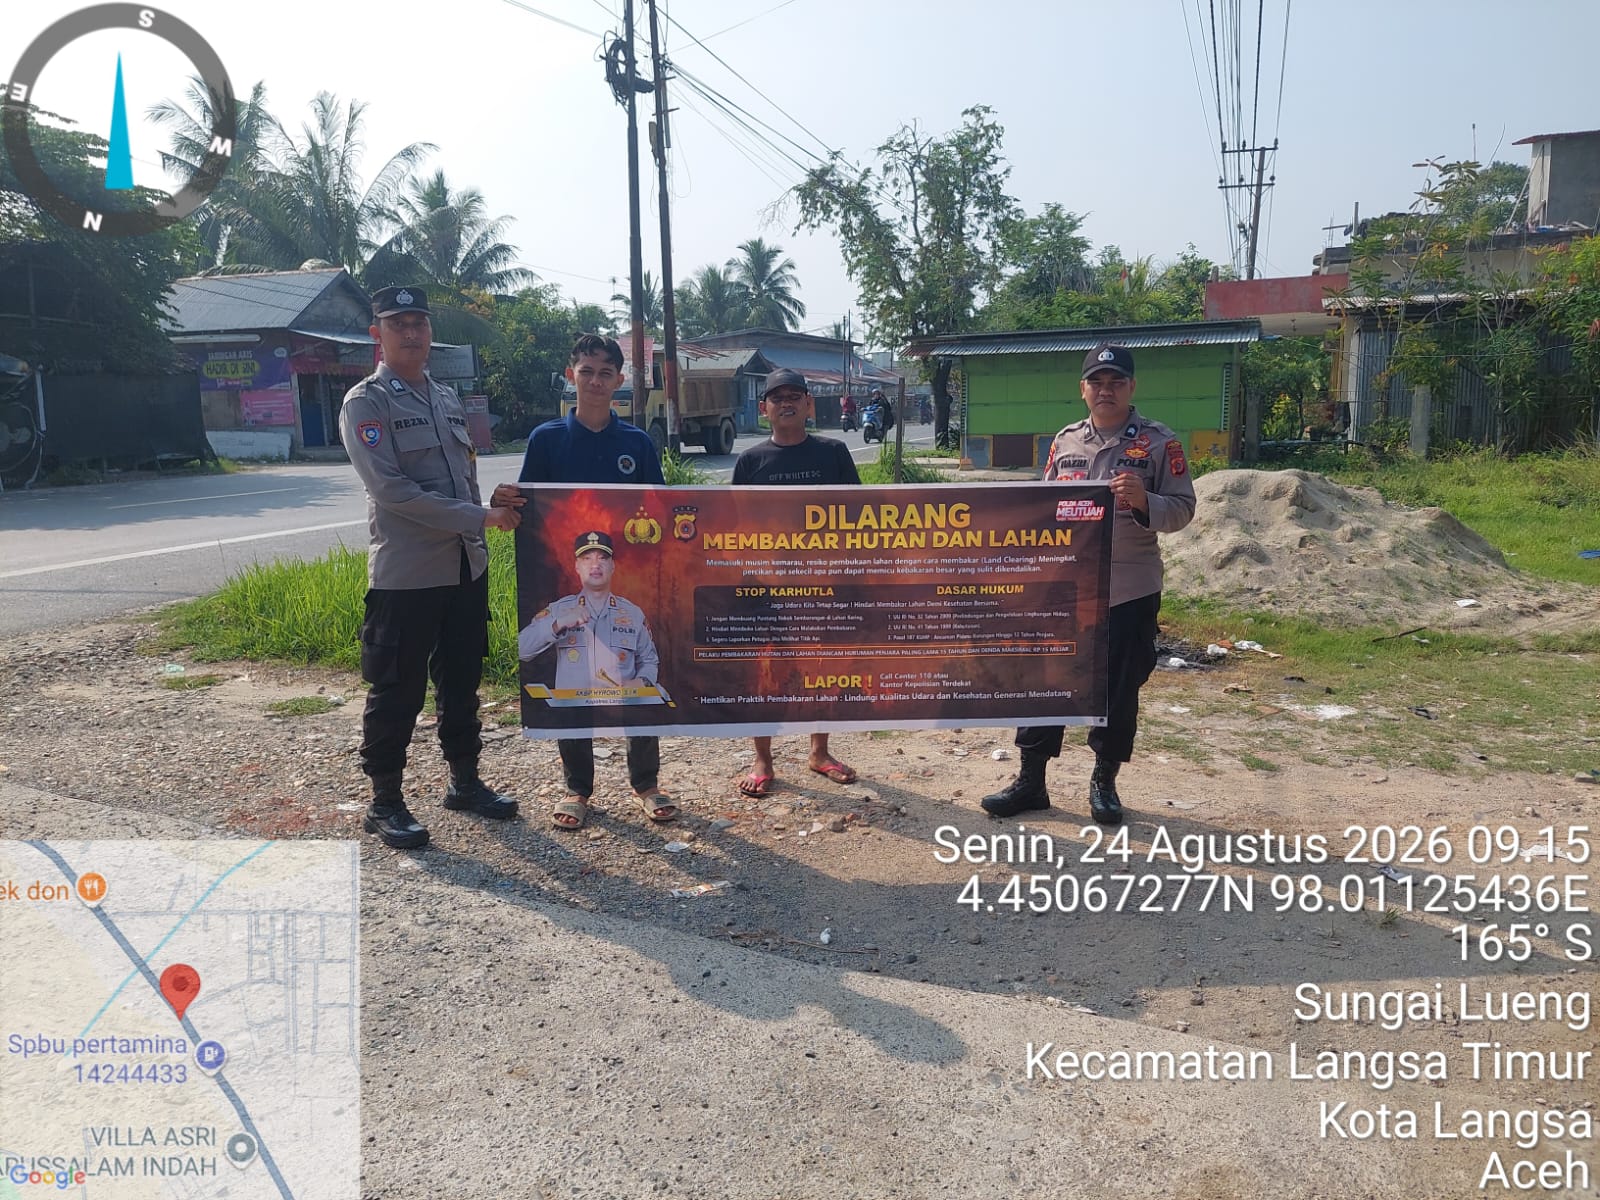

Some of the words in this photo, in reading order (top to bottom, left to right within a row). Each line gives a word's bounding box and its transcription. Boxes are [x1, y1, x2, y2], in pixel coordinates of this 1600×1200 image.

[394, 418, 430, 430] REZKI
[1116, 458, 1149, 469] POLRI
[805, 503, 971, 530] DILARANG
[1056, 506, 1104, 517] MEUTUAH
[703, 532, 839, 550] MEMBAKAR
[845, 530, 926, 549] HUTAN
[932, 530, 983, 548] DAN
[989, 528, 1072, 547] LAHAN
[706, 558, 744, 567] Memasuki
[745, 558, 770, 567] musim
[806, 558, 828, 567] resiko
[829, 558, 872, 568] pembukaan
[873, 557, 893, 566] lahan
[894, 557, 922, 566] dengan
[923, 557, 939, 565] cara
[940, 556, 979, 564] membakar
[742, 567, 774, 577] percikan
[775, 567, 786, 576] api
[787, 567, 812, 575] sekecil
[813, 568, 827, 576] apa
[827, 568, 843, 576] pun
[844, 567, 865, 576] dapat
[866, 567, 895, 575] memicu
[896, 566, 934, 574] kebakaran
[935, 566, 955, 574] besar
[957, 567, 975, 575] yang
[976, 565, 993, 573] sulit
[735, 587, 767, 597] STOP
[769, 586, 834, 597] KARHUTLA
[936, 585, 977, 595] DASAR
[980, 584, 1025, 594] HUKUM
[612, 626, 636, 634] POLRI
[804, 674, 862, 689] LAPOR
[867, 674, 873, 688] !
[904, 680, 940, 689] Kepolisian
[700, 696, 736, 704] Hentikan
[737, 695, 765, 703] Praktik
[767, 694, 814, 703] Pembakaran
[815, 694, 838, 702] Lahan
[844, 693, 878, 702] Lindungi
[911, 692, 934, 700] Udara
[952, 691, 992, 700] Kesehatan
[993, 690, 1027, 699] Generasi
[1028, 689, 1072, 699] Mendatang
